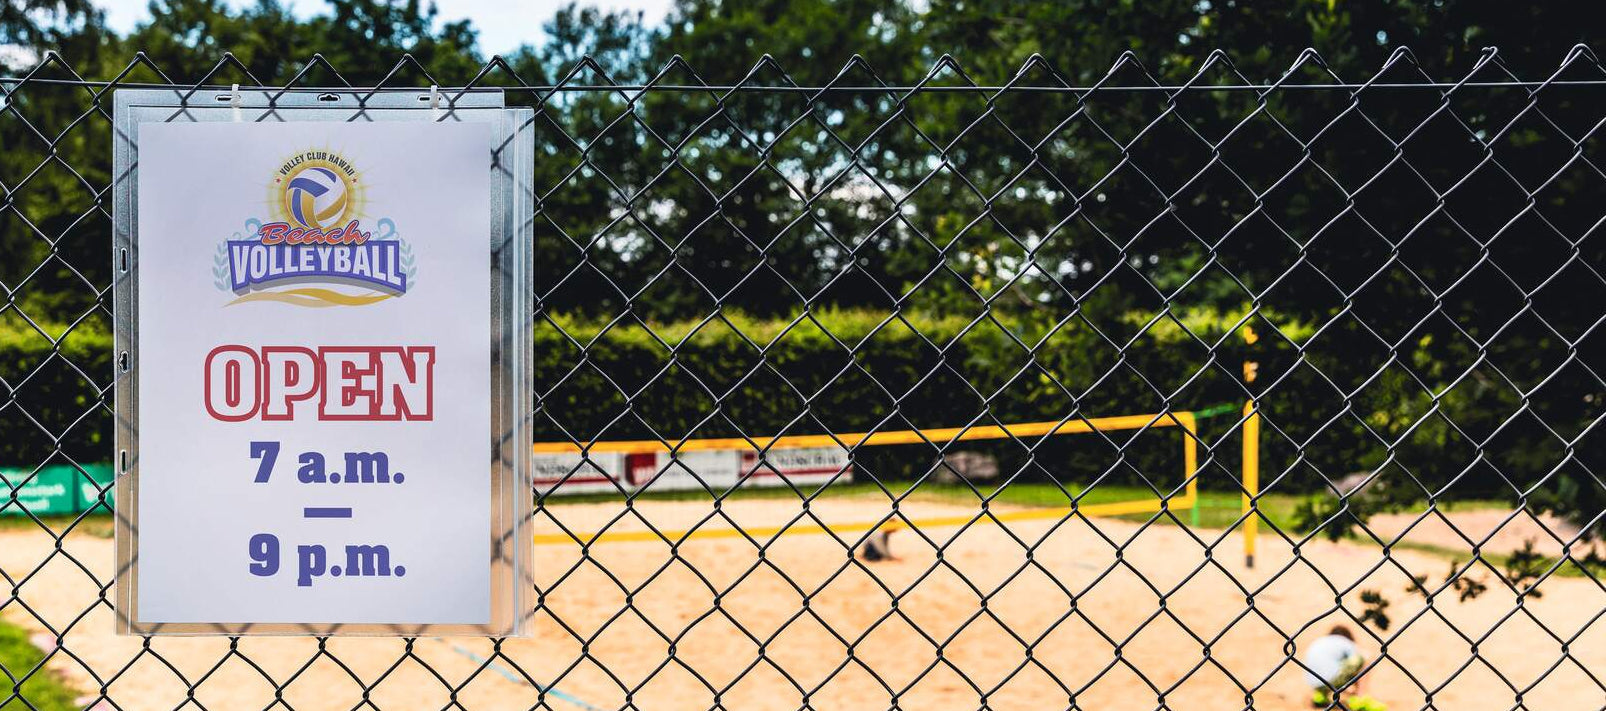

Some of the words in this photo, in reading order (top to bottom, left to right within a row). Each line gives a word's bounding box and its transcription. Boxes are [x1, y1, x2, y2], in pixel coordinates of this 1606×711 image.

[280, 154, 305, 176] VOLLEY
[306, 152, 327, 161] CLUB
[328, 154, 355, 177] HAWAII
[259, 220, 370, 246] Beach
[232, 245, 402, 286] VOLLEYBALL
[204, 344, 436, 422] OPEN
[250, 441, 280, 483] 7
[297, 451, 405, 484] a.m.
[248, 533, 280, 577] 9
[297, 544, 406, 587] p.m.
